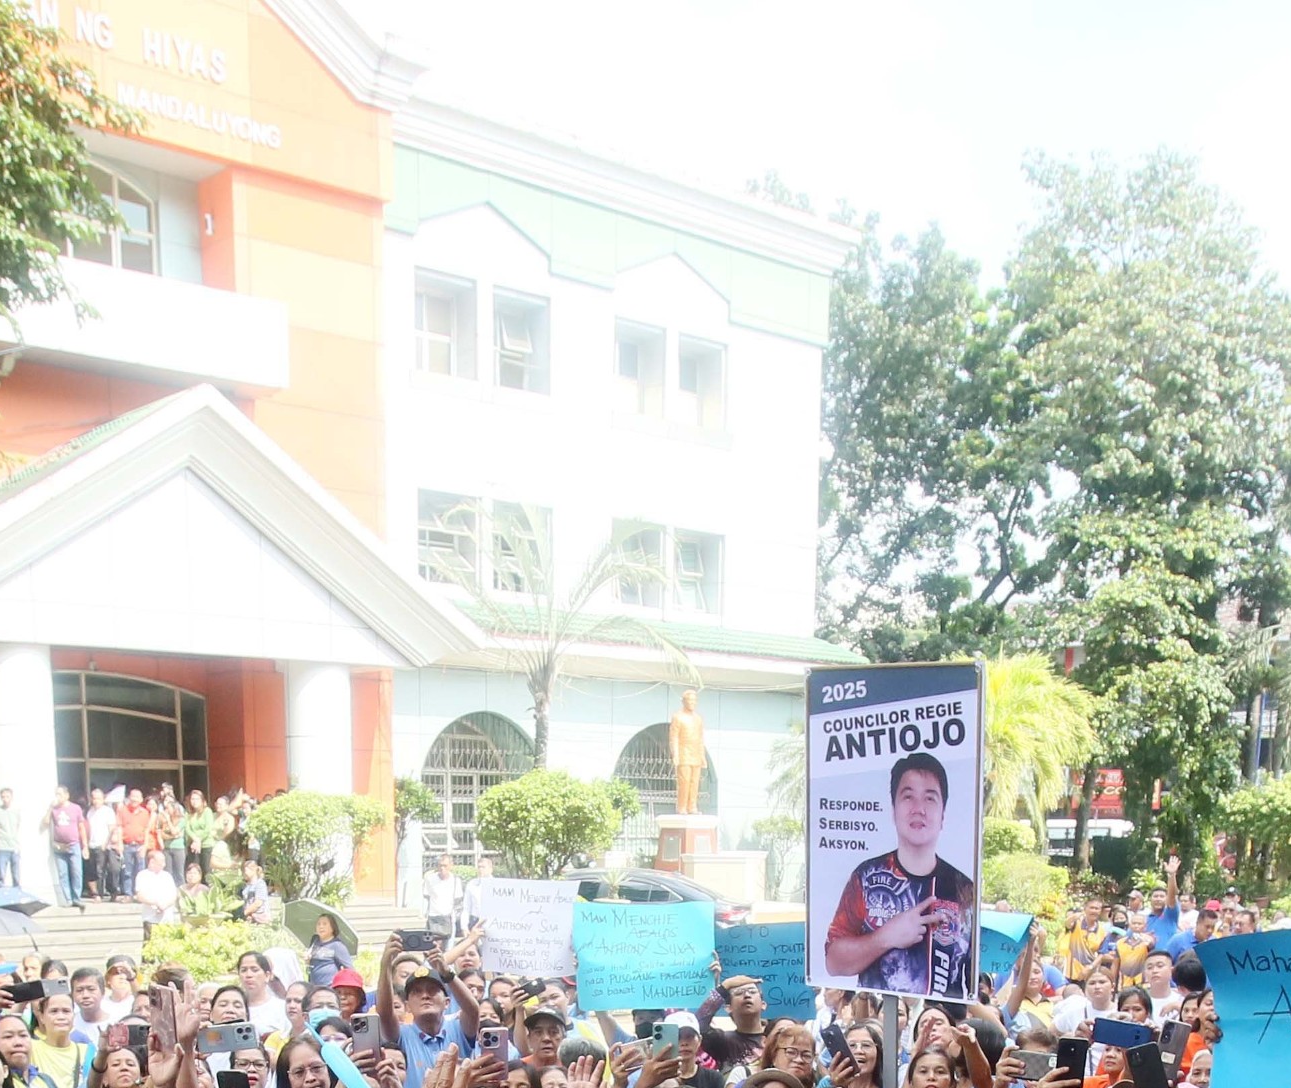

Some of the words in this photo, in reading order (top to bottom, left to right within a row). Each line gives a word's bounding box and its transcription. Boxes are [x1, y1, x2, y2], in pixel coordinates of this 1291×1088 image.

[74, 10, 114, 50] NG
[142, 29, 228, 84] HIYAS
[116, 82, 282, 149] MANDALUYONG
[822, 680, 867, 704] 2025
[823, 709, 910, 734] COUNCILOR
[915, 701, 963, 720] REGIE
[825, 718, 966, 762] ANTIOJO
[819, 798, 883, 812] RESPONDE.
[819, 818, 878, 832] SERBISYO.
[819, 837, 869, 851] AKSYON.
